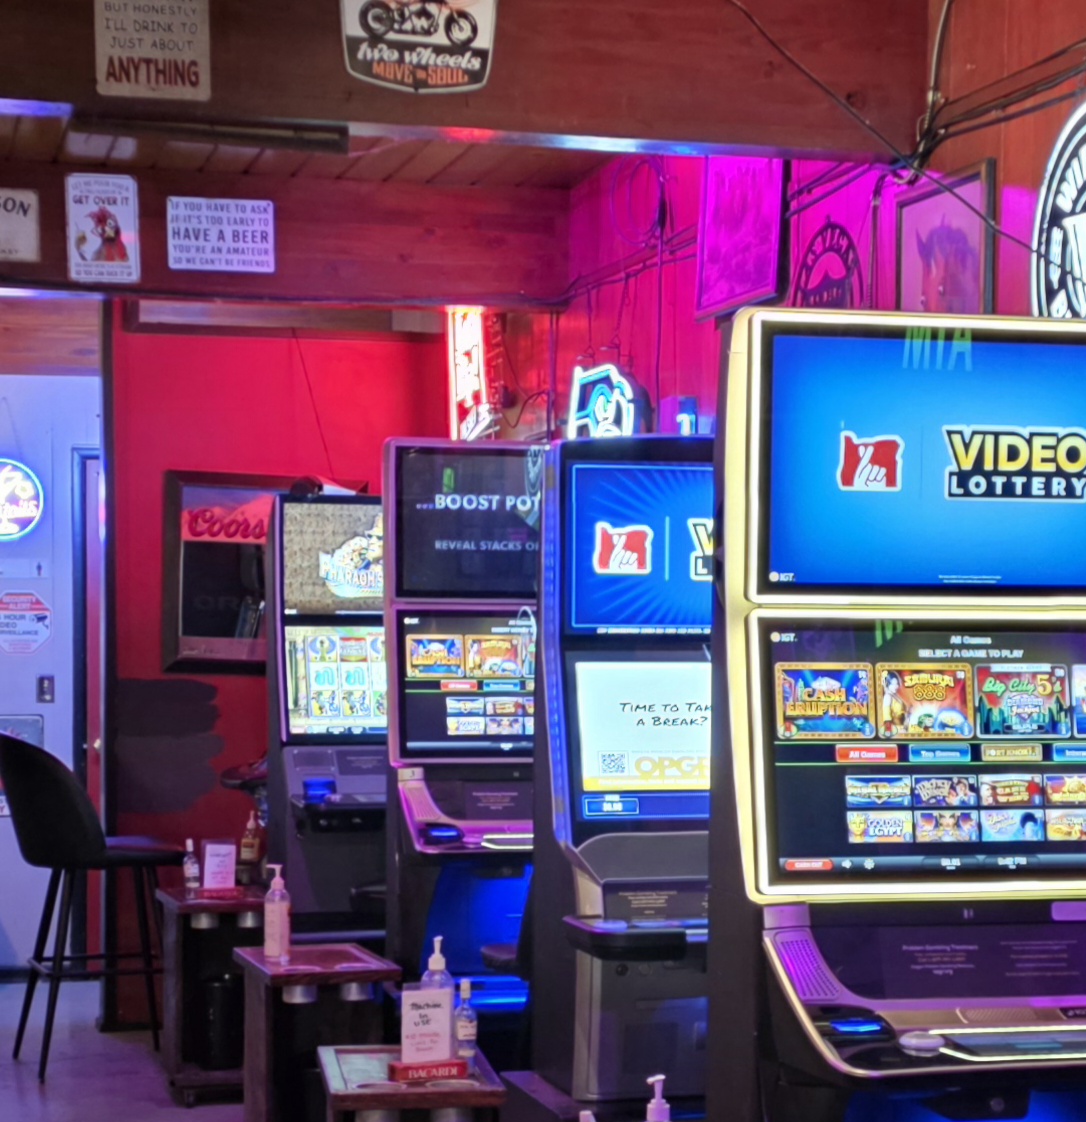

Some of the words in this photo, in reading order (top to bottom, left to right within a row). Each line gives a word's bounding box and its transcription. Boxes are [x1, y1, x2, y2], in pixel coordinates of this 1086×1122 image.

[104, 2, 128, 12] BUT
[133, 4, 197, 17] HONESTLY
[133, 20, 174, 33] DRINK
[181, 22, 198, 35] TO
[110, 36, 144, 48] JUST
[150, 40, 194, 52] ABOUT
[357, 42, 399, 62] two
[404, 47, 482, 71] wheels
[106, 56, 199, 88] ANYTHING
[0, 197, 31, 217] ON
[73, 195, 90, 205] GET
[93, 196, 118, 206] OVER
[121, 197, 130, 206] IT
[171, 201, 180, 210] IF
[183, 202, 202, 212] YOU
[206, 202, 231, 214] HAVE
[235, 204, 246, 214] TO
[250, 205, 269, 214] ASK
[205, 216, 224, 226] TOO
[227, 217, 255, 227] EARLY
[258, 218, 270, 227] TO
[172, 227, 212, 242] HAVE
[217, 229, 226, 243] A
[232, 229, 269, 244] BEER
[172, 244, 206, 254] YOU'RE
[210, 246, 222, 254] AN
[226, 246, 269, 256] AMATEUR
[173, 256, 182, 265] SO
[185, 257, 196, 266] WE
[225, 258, 234, 267] BE
[237, 259, 270, 268] FRIENDS
[435, 494, 500, 511] BOOST
[187, 508, 267, 539] Coors
[435, 540, 476, 550] REVEAL
[480, 541, 522, 551] STACKS
[918, 648, 952, 658] SELECT
[1002, 650, 1024, 658] PLAY
[903, 673, 954, 688] SAMURAI
[982, 679, 1006, 697] Big
[1009, 678, 1036, 694] City
[804, 688, 846, 702] CASH
[619, 702, 656, 713] TIME
[662, 703, 680, 713] TO
[786, 702, 868, 716] ERUPTION
[636, 718, 646, 726] A
[651, 716, 708, 727] BREAK?
[408, 1066, 458, 1079] BACARDI
